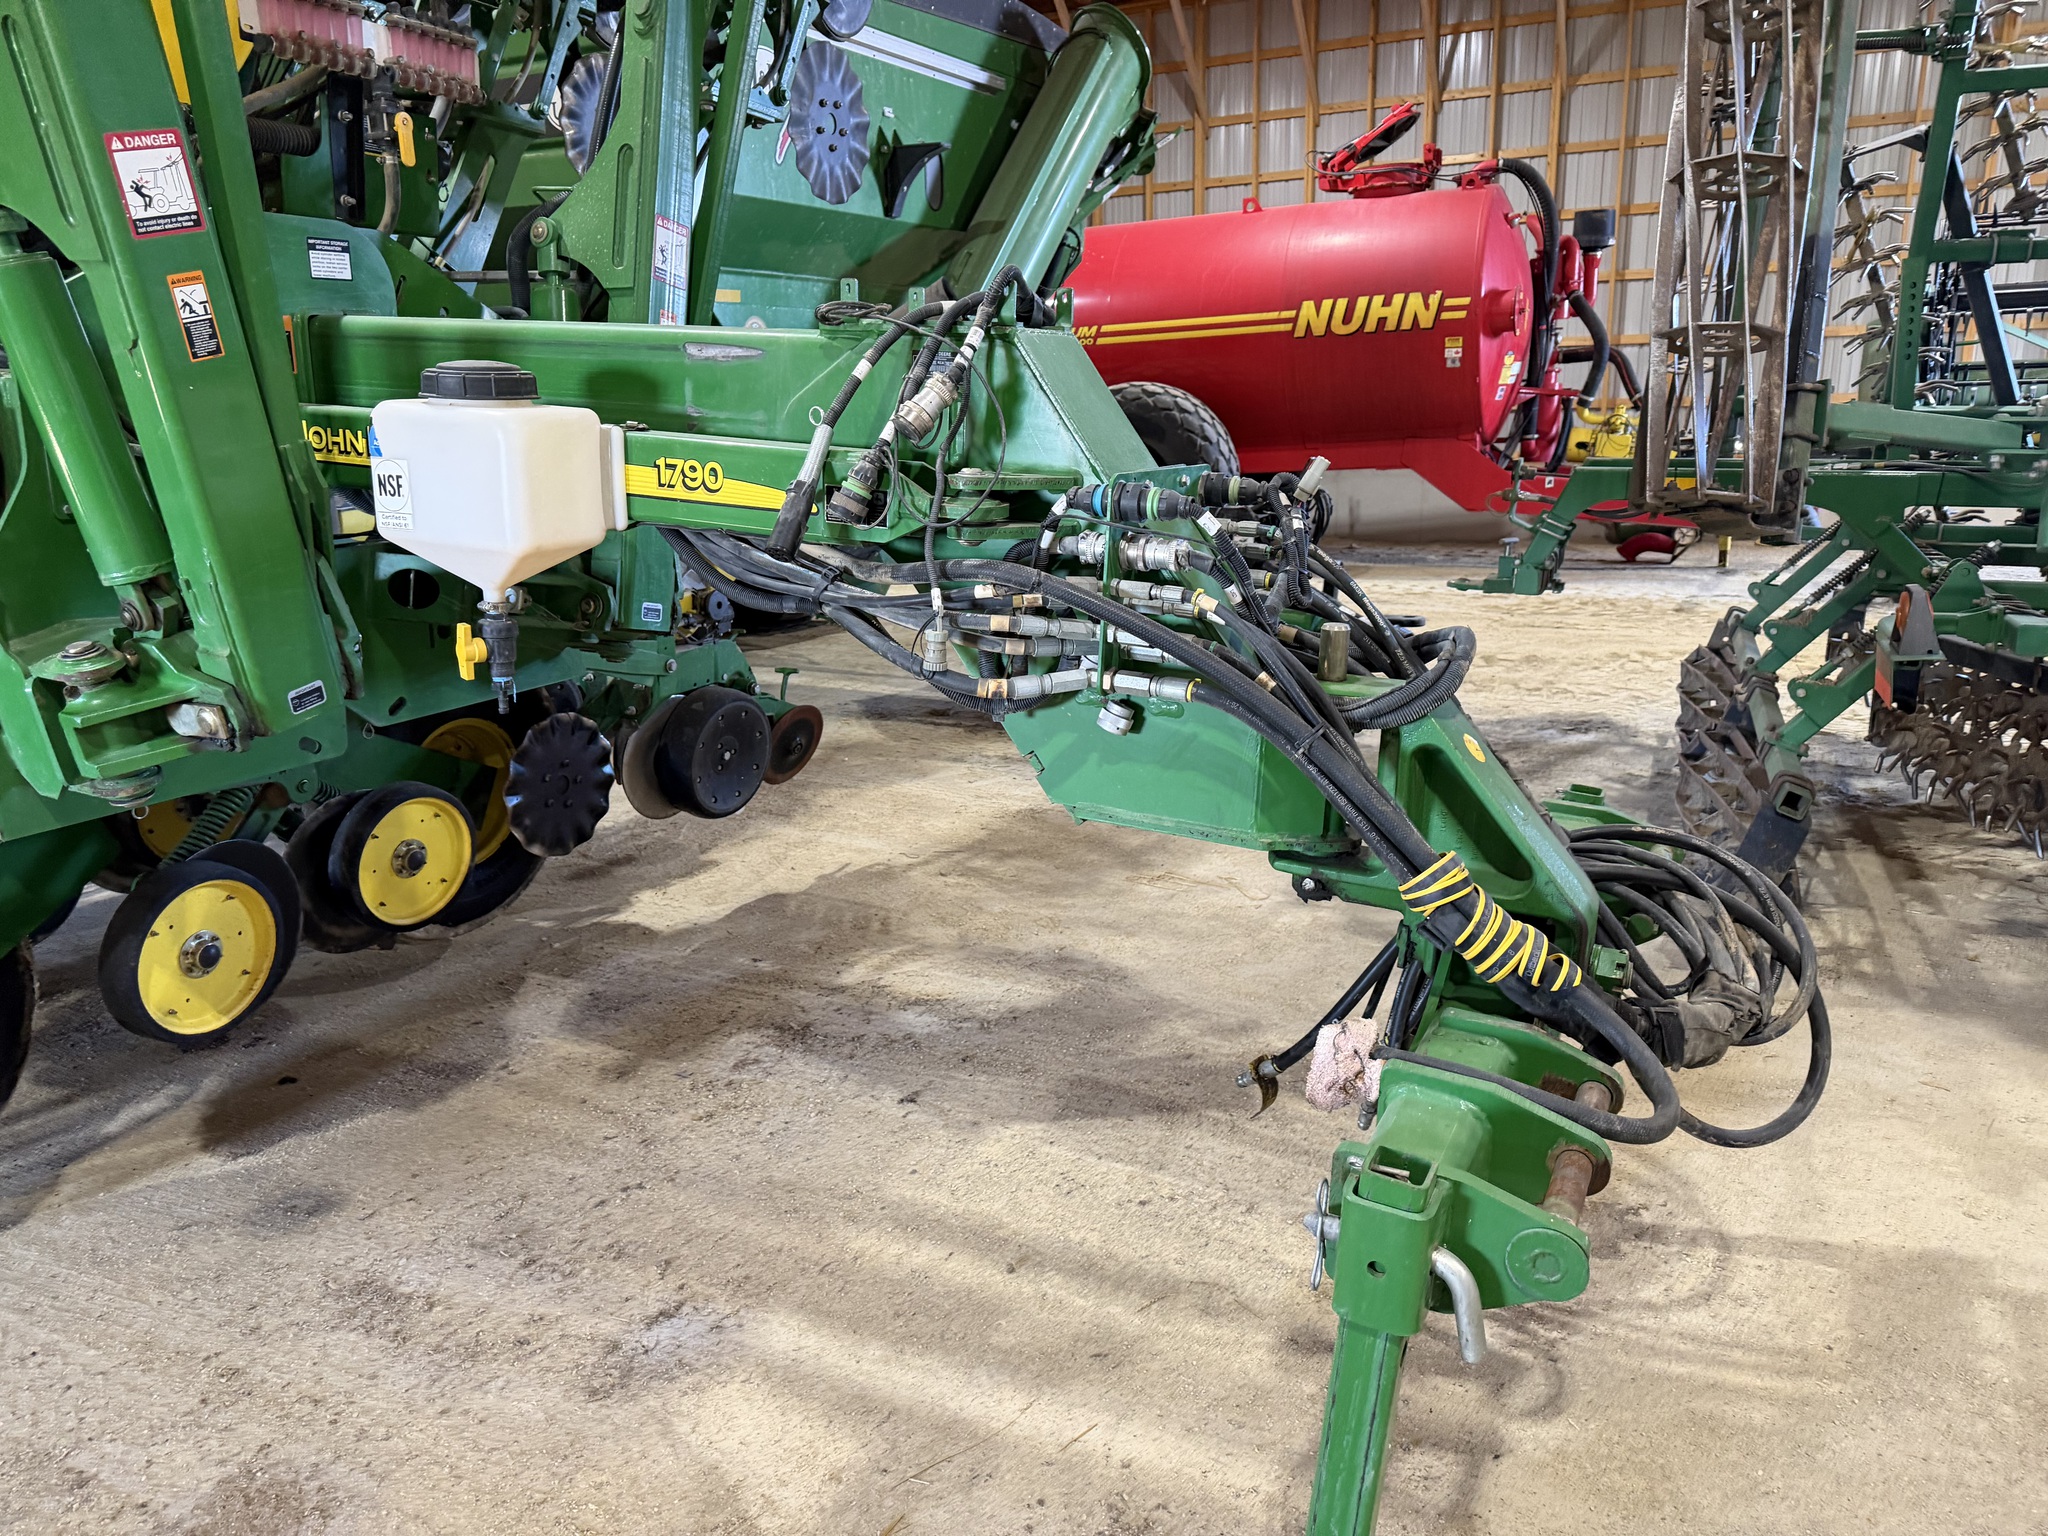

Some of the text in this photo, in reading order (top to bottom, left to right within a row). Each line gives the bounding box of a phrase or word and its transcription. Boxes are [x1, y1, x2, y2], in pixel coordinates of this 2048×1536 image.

[123, 133, 177, 148] DANGER
[147, 224, 164, 232] contact
[157, 217, 171, 226] injury
[176, 275, 203, 284] WARNING
[1293, 290, 1443, 338] NUHN
[654, 456, 725, 494] 1790
[377, 473, 403, 498] NSF
